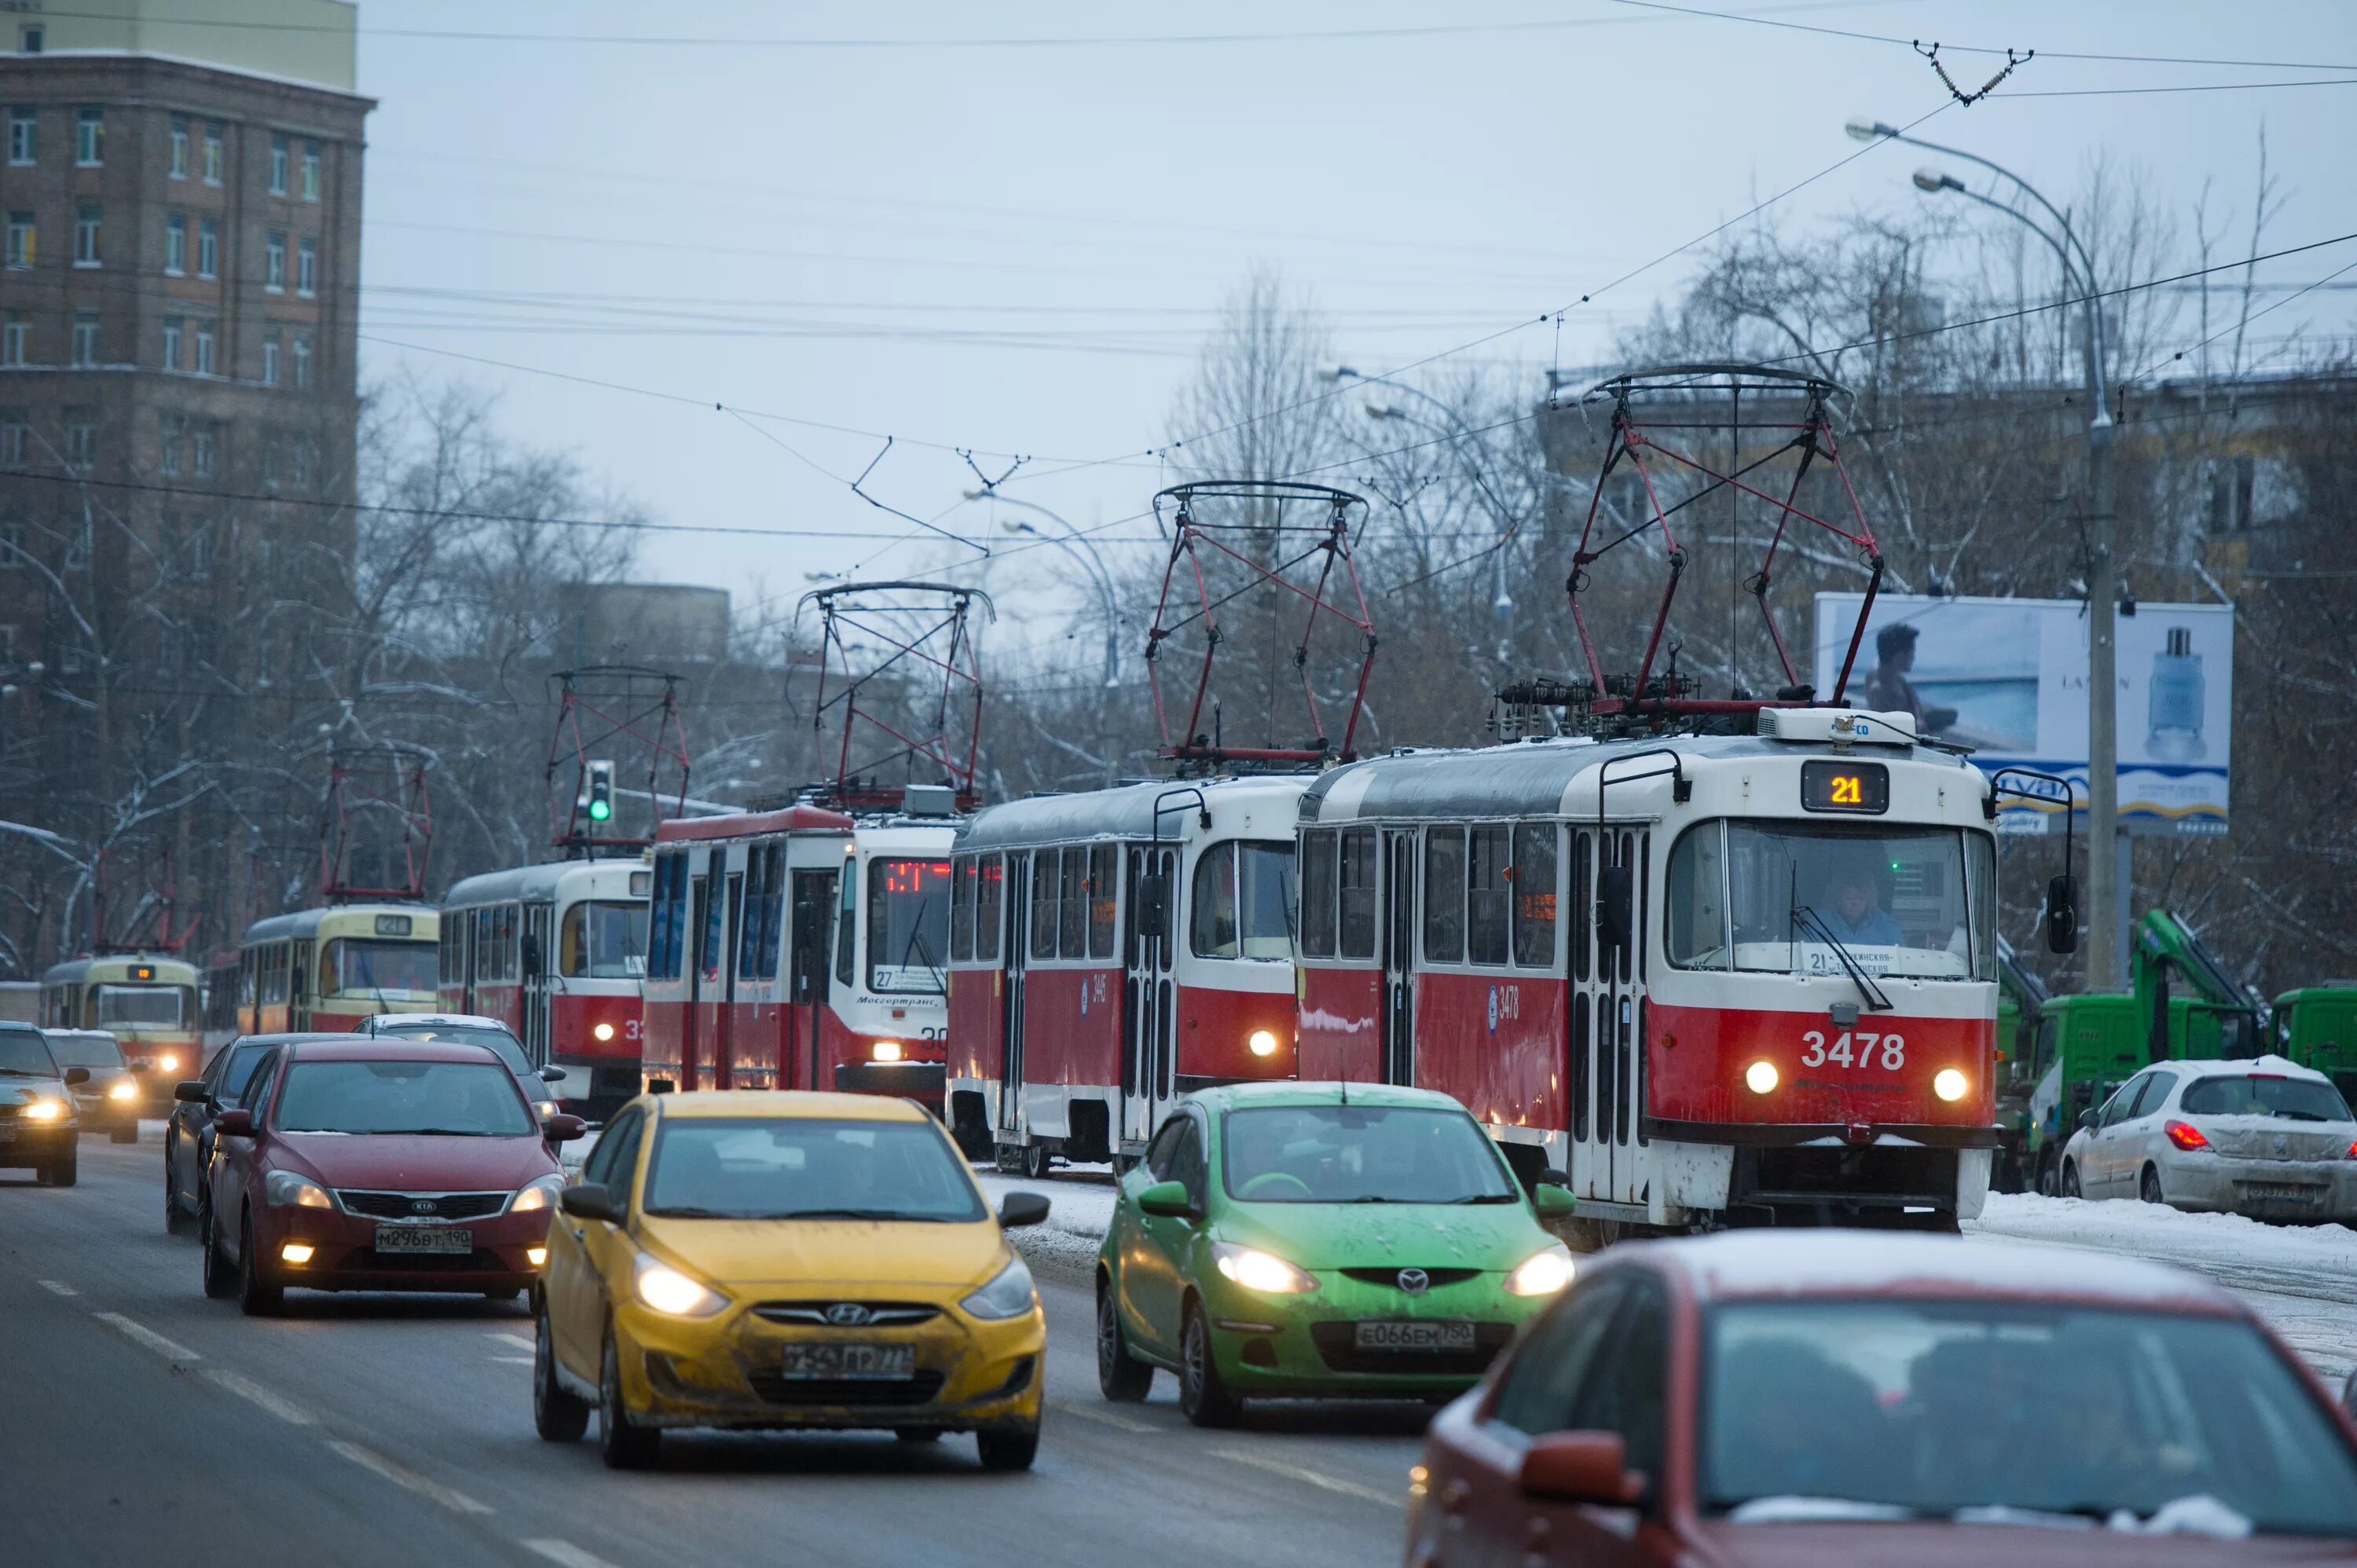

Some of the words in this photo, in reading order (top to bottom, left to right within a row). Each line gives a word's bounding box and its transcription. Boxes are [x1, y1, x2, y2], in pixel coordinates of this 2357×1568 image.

[1831, 776, 1861, 802] 21
[1810, 953, 1826, 969] 21
[876, 971, 893, 987] 27
[1500, 985, 1519, 1020] 3478
[1801, 1030, 1904, 1071] 3478
